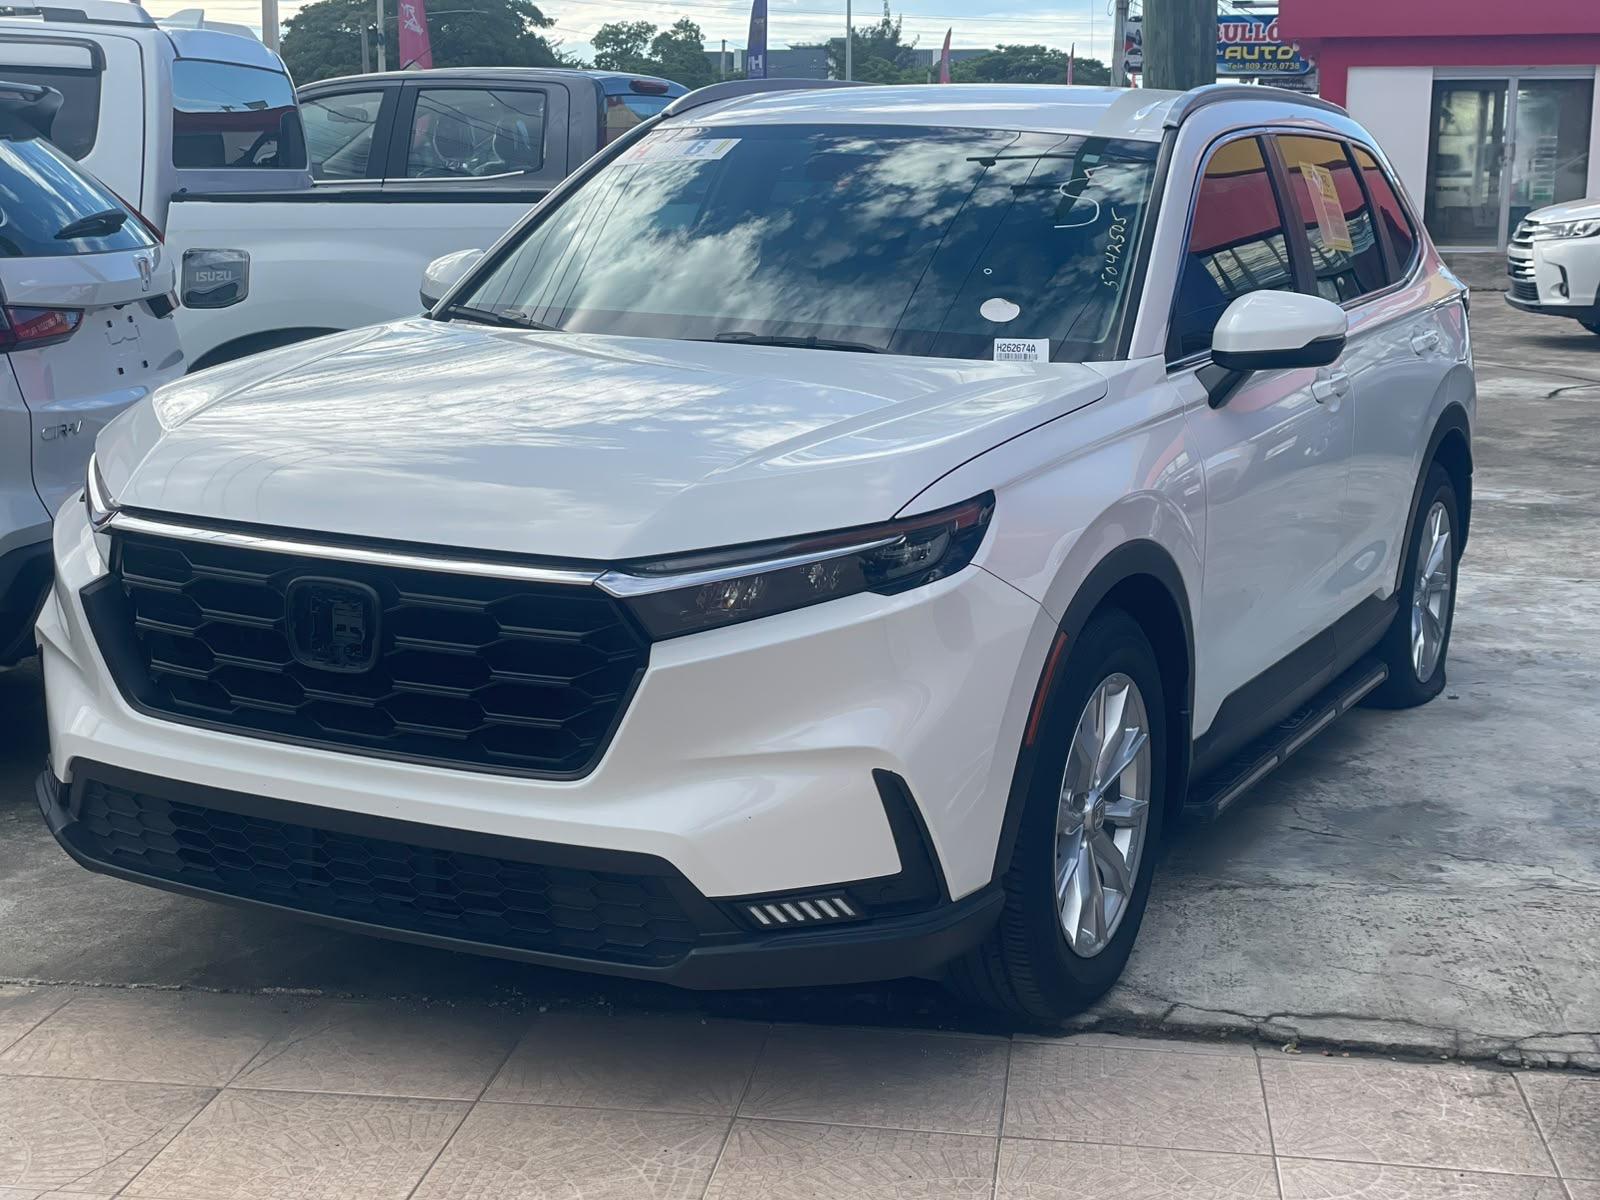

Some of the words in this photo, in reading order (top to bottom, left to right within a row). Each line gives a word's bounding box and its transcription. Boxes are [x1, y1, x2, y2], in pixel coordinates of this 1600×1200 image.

[1224, 45, 1294, 60] AUTO
[1101, 207, 1127, 291] 5042505
[195, 271, 232, 282] ISUZU
[996, 343, 1036, 354] H262674A
